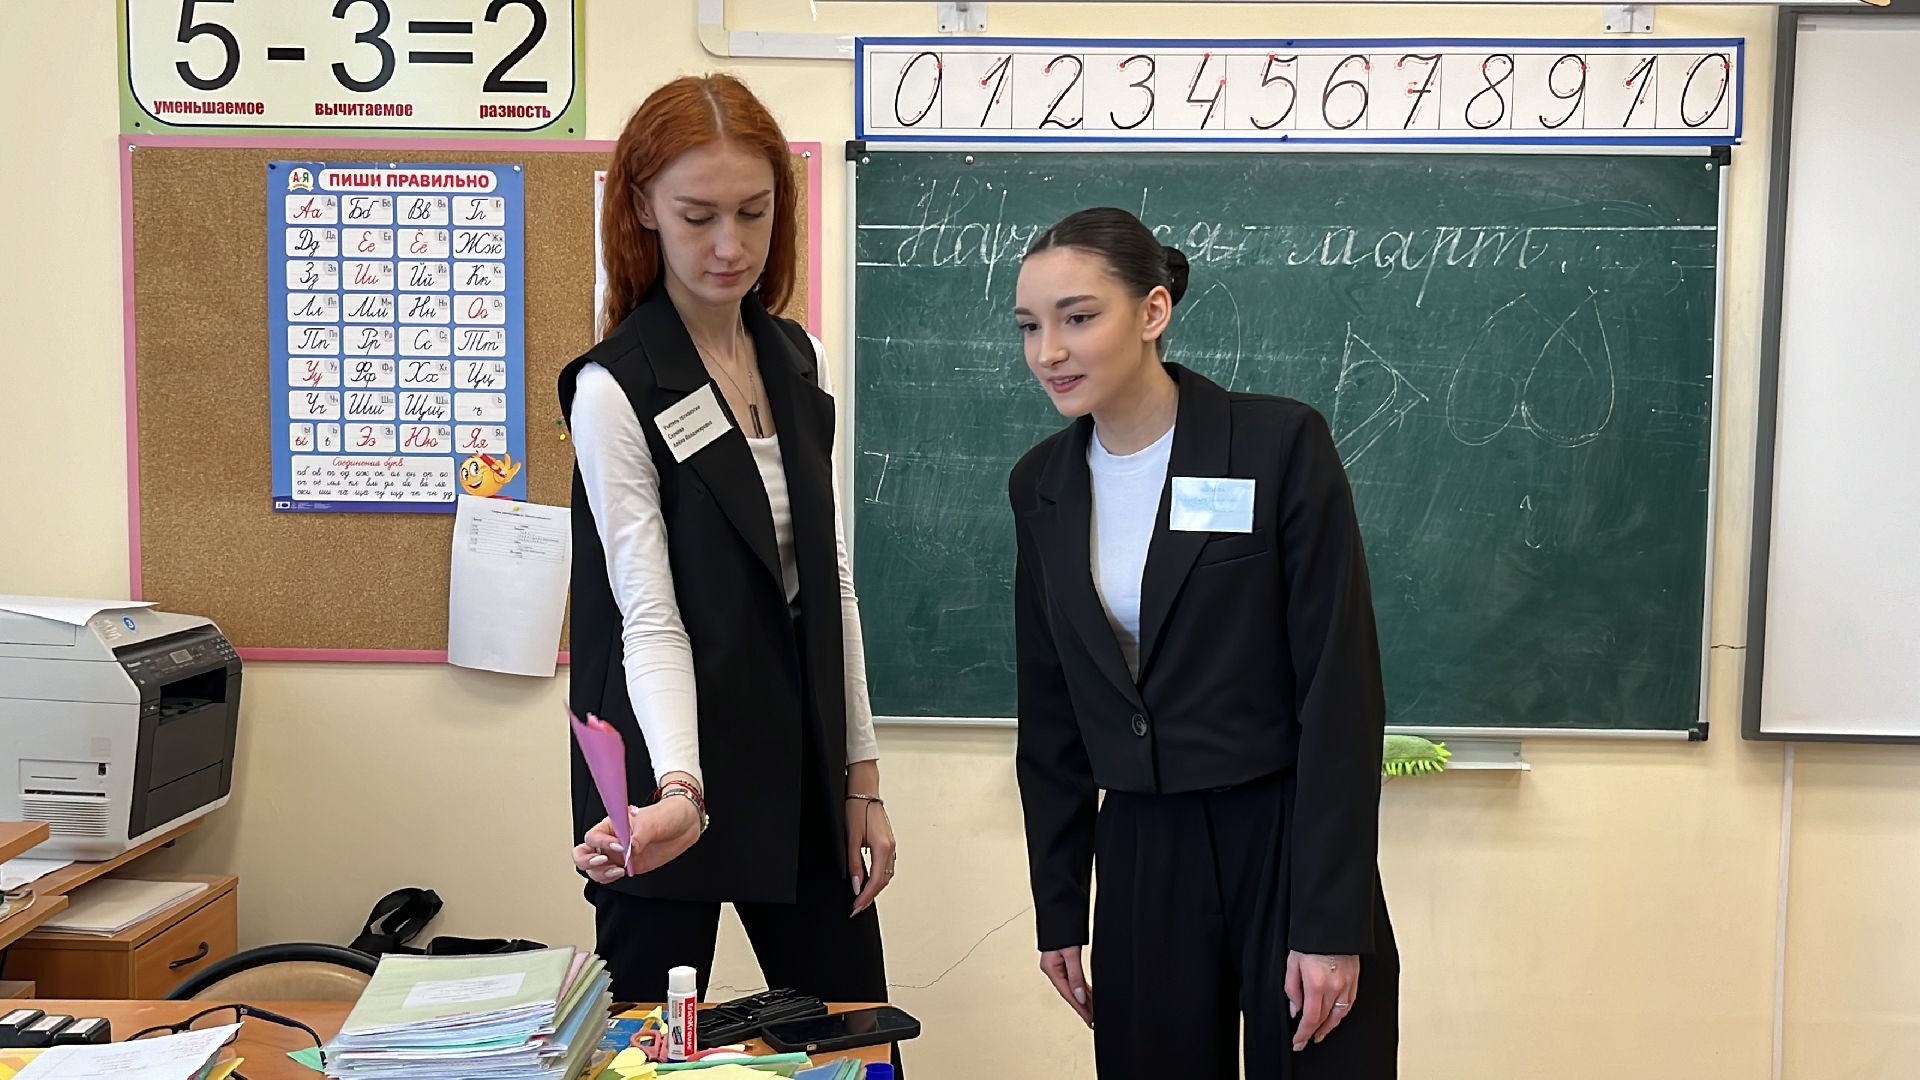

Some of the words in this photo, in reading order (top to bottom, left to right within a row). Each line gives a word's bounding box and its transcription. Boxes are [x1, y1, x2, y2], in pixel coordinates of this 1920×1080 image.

[175, 0, 240, 90] 5
[895, 52, 942, 126] 0
[982, 54, 1012, 127] 1
[1039, 54, 1083, 129] 2
[1110, 54, 1155, 129] 3
[1186, 53, 1225, 129] 4
[1250, 54, 1298, 129] 5
[1322, 54, 1369, 129] 6
[1399, 53, 1442, 129] 7
[1465, 53, 1514, 129] 8
[1539, 53, 1586, 128] 9
[154, 100, 264, 116] уменьшаемое
[315, 102, 413, 118] вычитаемое
[480, 104, 550, 119] разность
[330, 173, 381, 187] ПИШИ
[387, 174, 489, 188] ПРАВИЛЬНО
[293, 197, 323, 219] Аа
[348, 197, 379, 220] Бб
[407, 198, 431, 220] Вв
[465, 199, 488, 220] Гг
[294, 229, 320, 257] Дд
[358, 231, 376, 253] Ее
[410, 229, 428, 254] Ёё
[455, 231, 502, 254] Жж
[300, 262, 320, 290] Зз
[354, 263, 379, 285] Ии
[411, 262, 435, 287] Йй
[467, 265, 491, 287] Кк
[293, 295, 324, 317] Лл
[348, 296, 390, 318] Мм
[408, 297, 436, 318] Нн
[467, 297, 489, 319] Оо
[298, 328, 330, 350] Пп
[357, 328, 381, 356] Рр
[414, 329, 433, 351] Сс
[457, 330, 498, 352] Тт
[302, 360, 323, 387] Уу
[350, 361, 377, 387] Фф
[405, 362, 439, 383] Хх
[467, 363, 495, 389] Цц
[306, 392, 327, 414] Чч
[348, 394, 385, 415] Шш
[404, 394, 446, 421] Щщ
[356, 426, 376, 447] Ээ
[404, 427, 439, 447] Юю
[462, 428, 489, 448] Яя
[333, 457, 380, 469] Соединения
